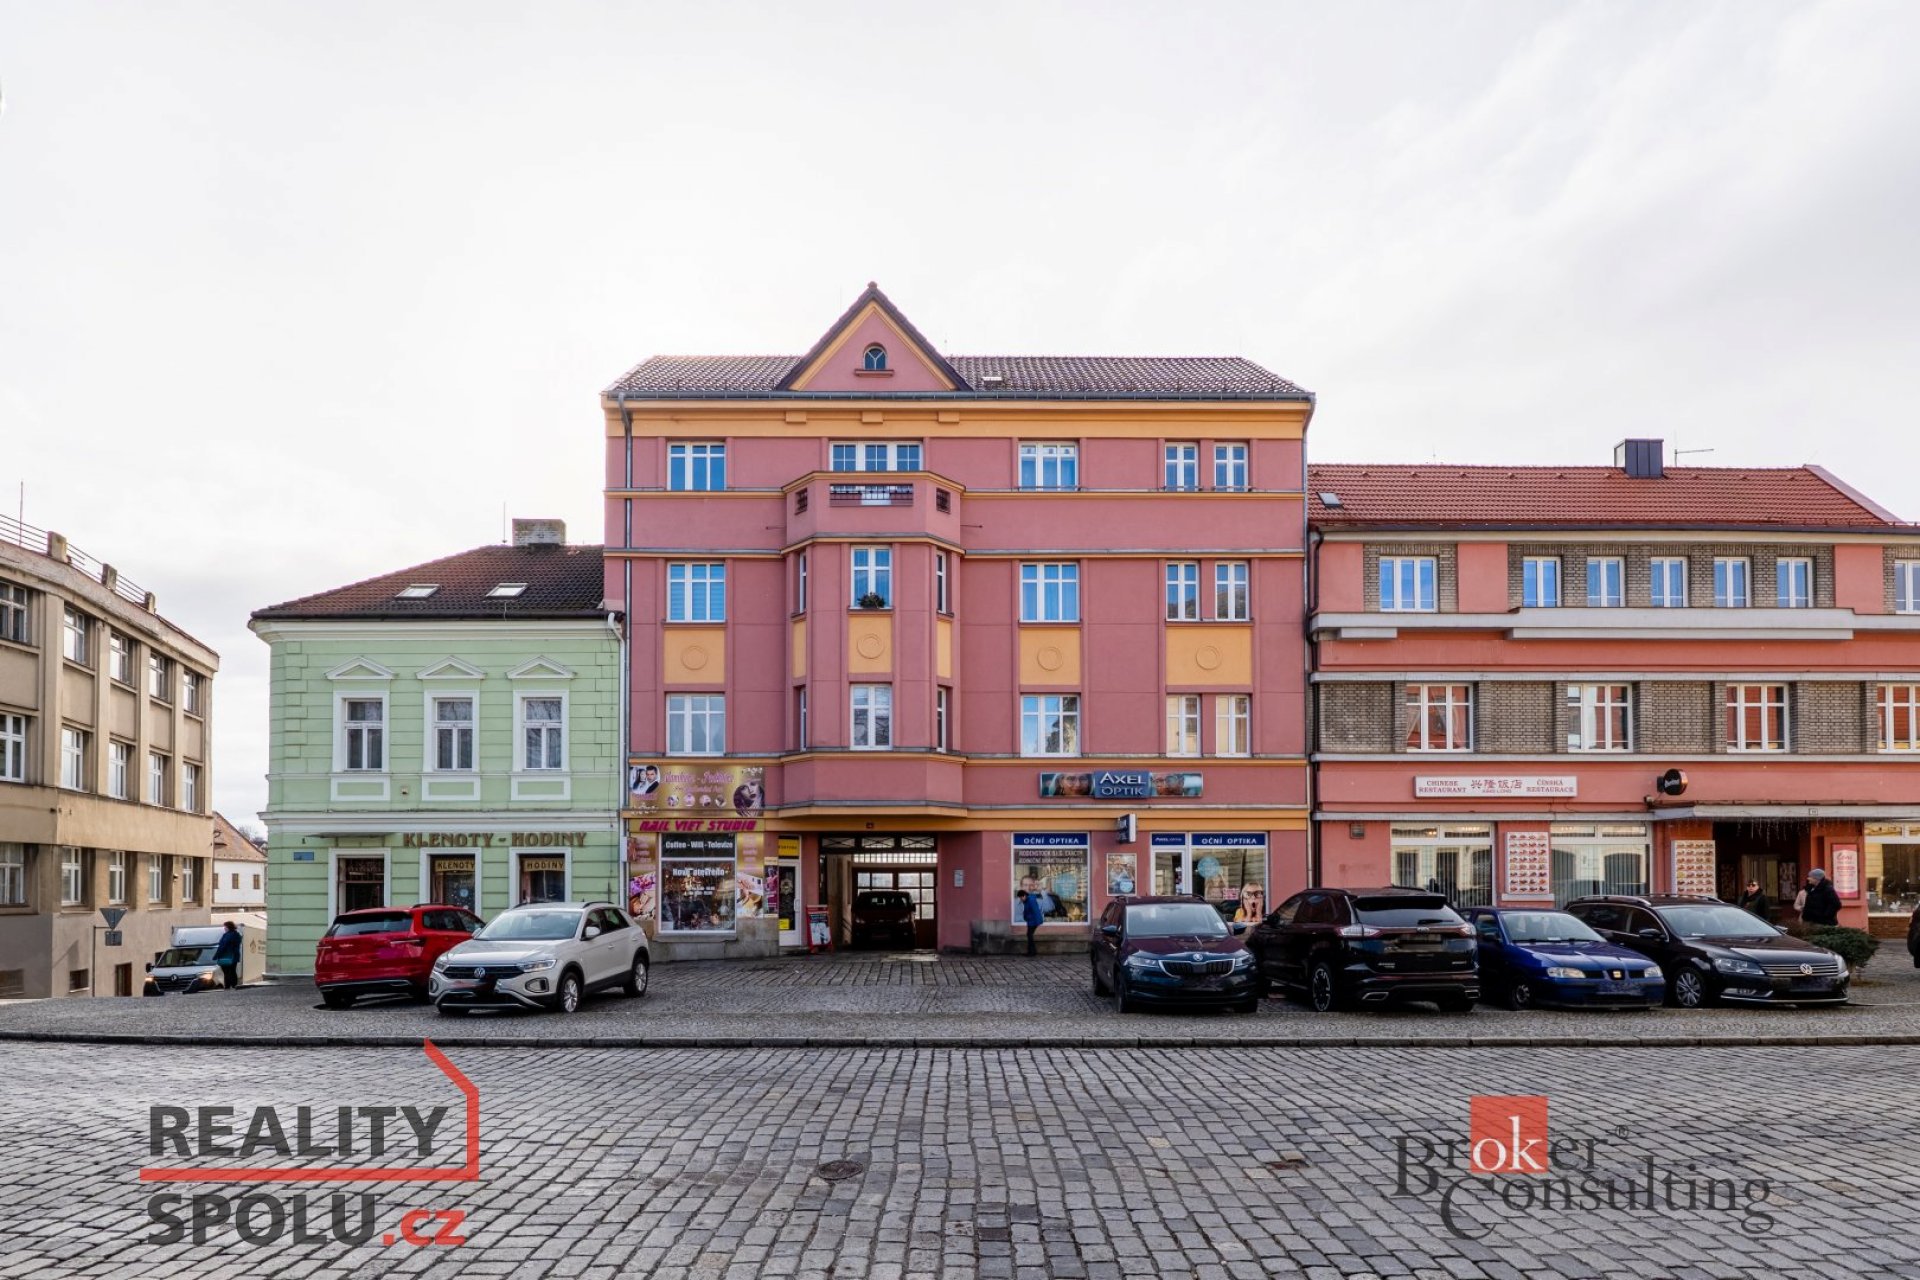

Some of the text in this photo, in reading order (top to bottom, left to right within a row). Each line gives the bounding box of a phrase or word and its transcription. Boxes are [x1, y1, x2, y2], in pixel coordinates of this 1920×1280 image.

[1100, 772, 1146, 785] AXEL
[1101, 787, 1143, 796] OPTIK
[640, 820, 756, 831] NAIL VIET STUDIO
[402, 832, 494, 848] KLENOTY
[511, 832, 587, 847] HODINY
[1023, 836, 1079, 845] OČNÍ OPTIKA
[1201, 836, 1257, 845] OČNÍ OPTIKA
[437, 860, 475, 869] KLENOTY
[526, 860, 564, 869] HODINY
